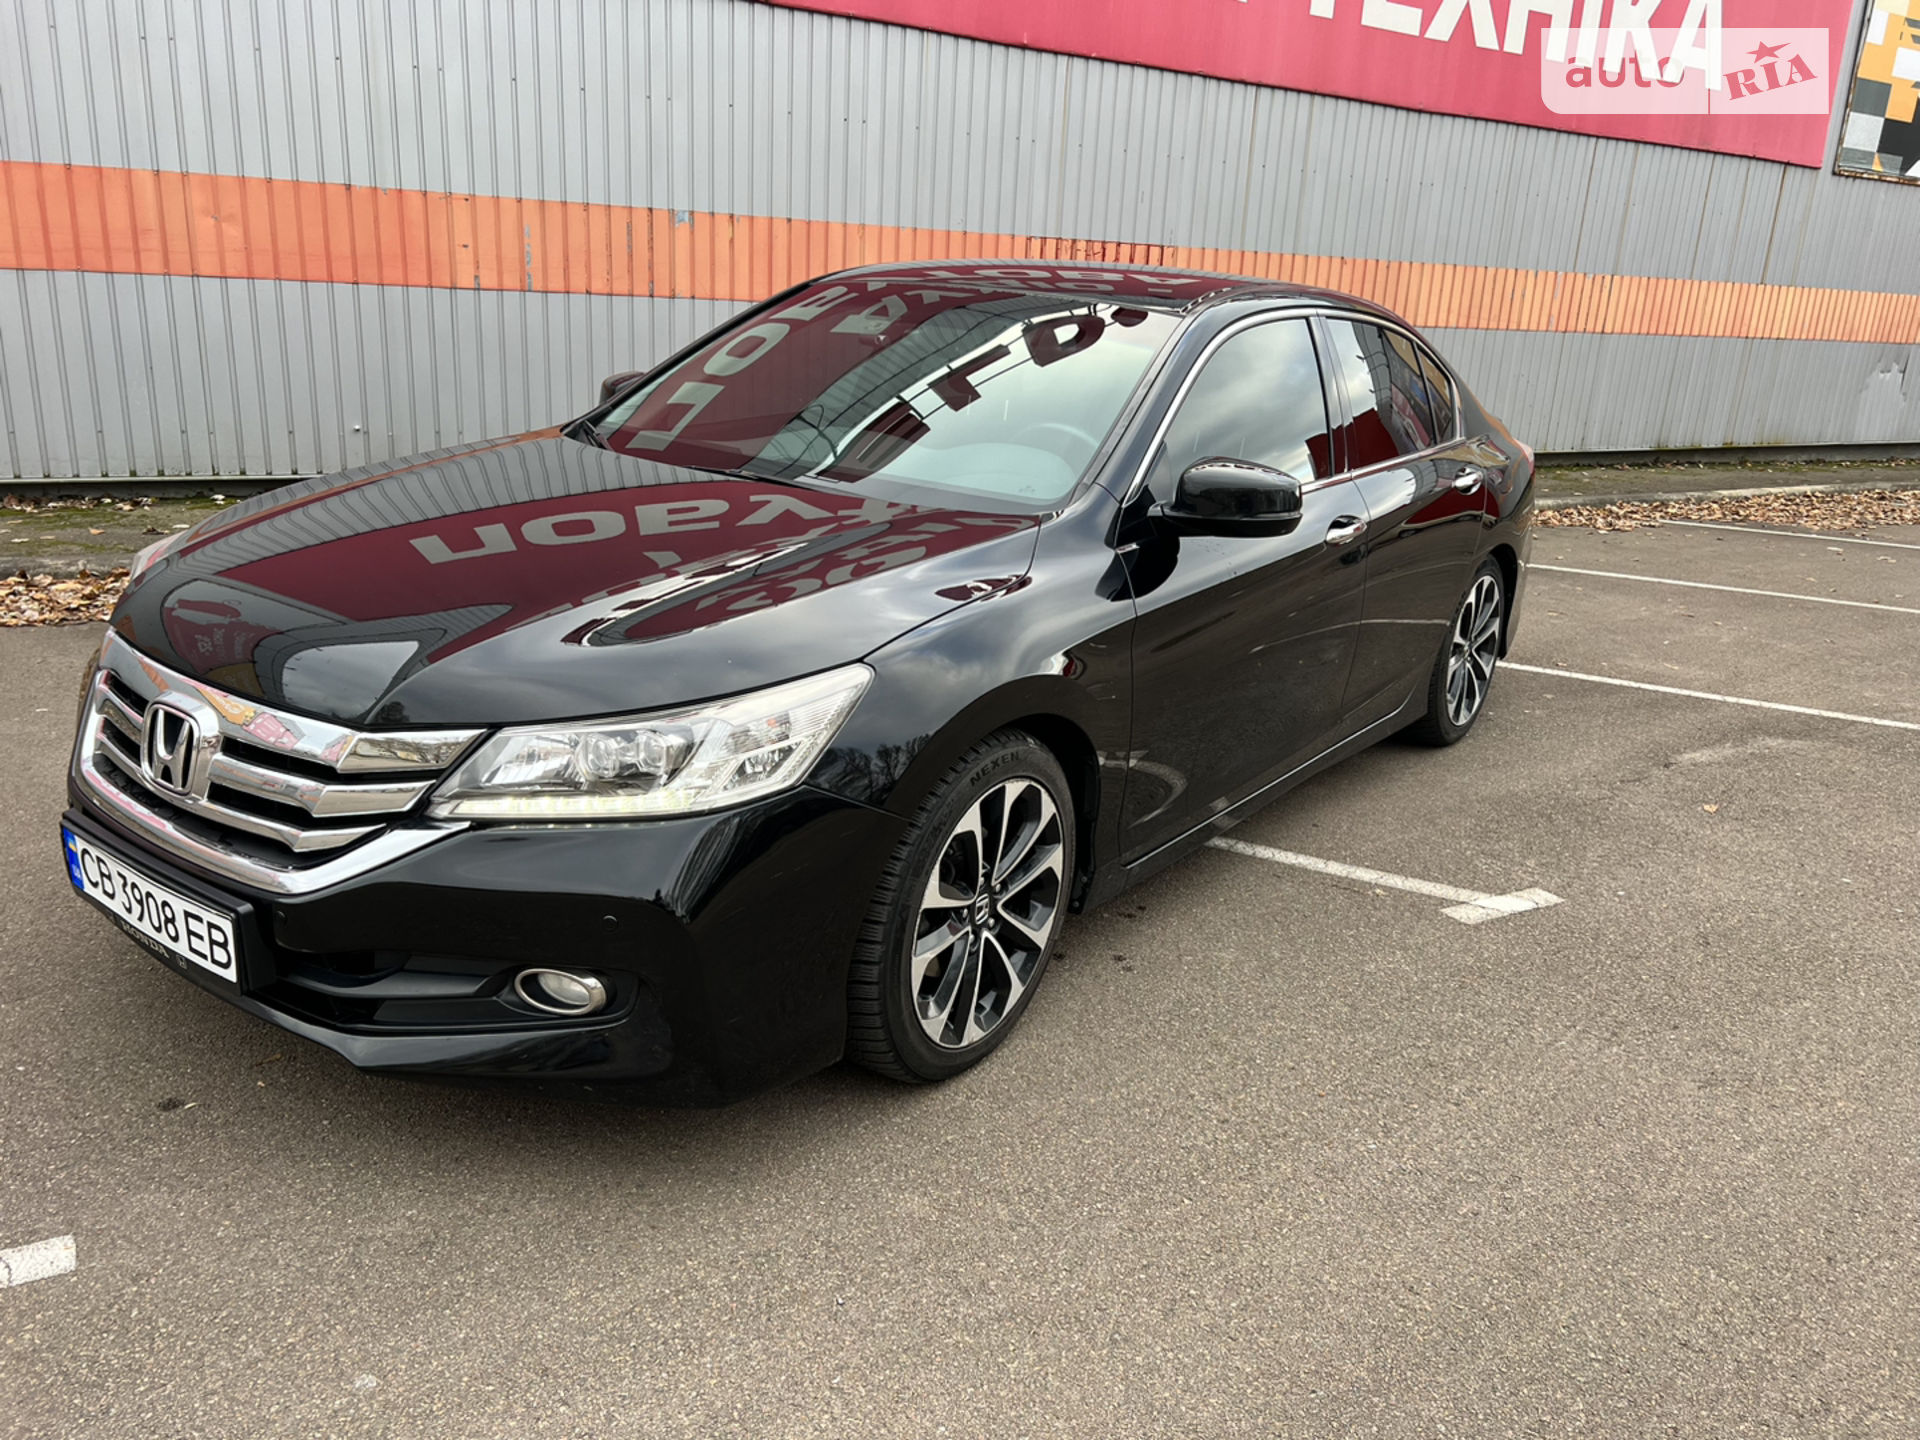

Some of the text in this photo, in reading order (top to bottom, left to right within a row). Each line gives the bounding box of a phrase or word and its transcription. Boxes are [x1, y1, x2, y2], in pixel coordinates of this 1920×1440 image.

[1309, 0, 1722, 92] НІКА
[969, 751, 1020, 787] NEXEN
[81, 847, 232, 970] CB 3908 EB
[120, 919, 170, 959] HONDA
